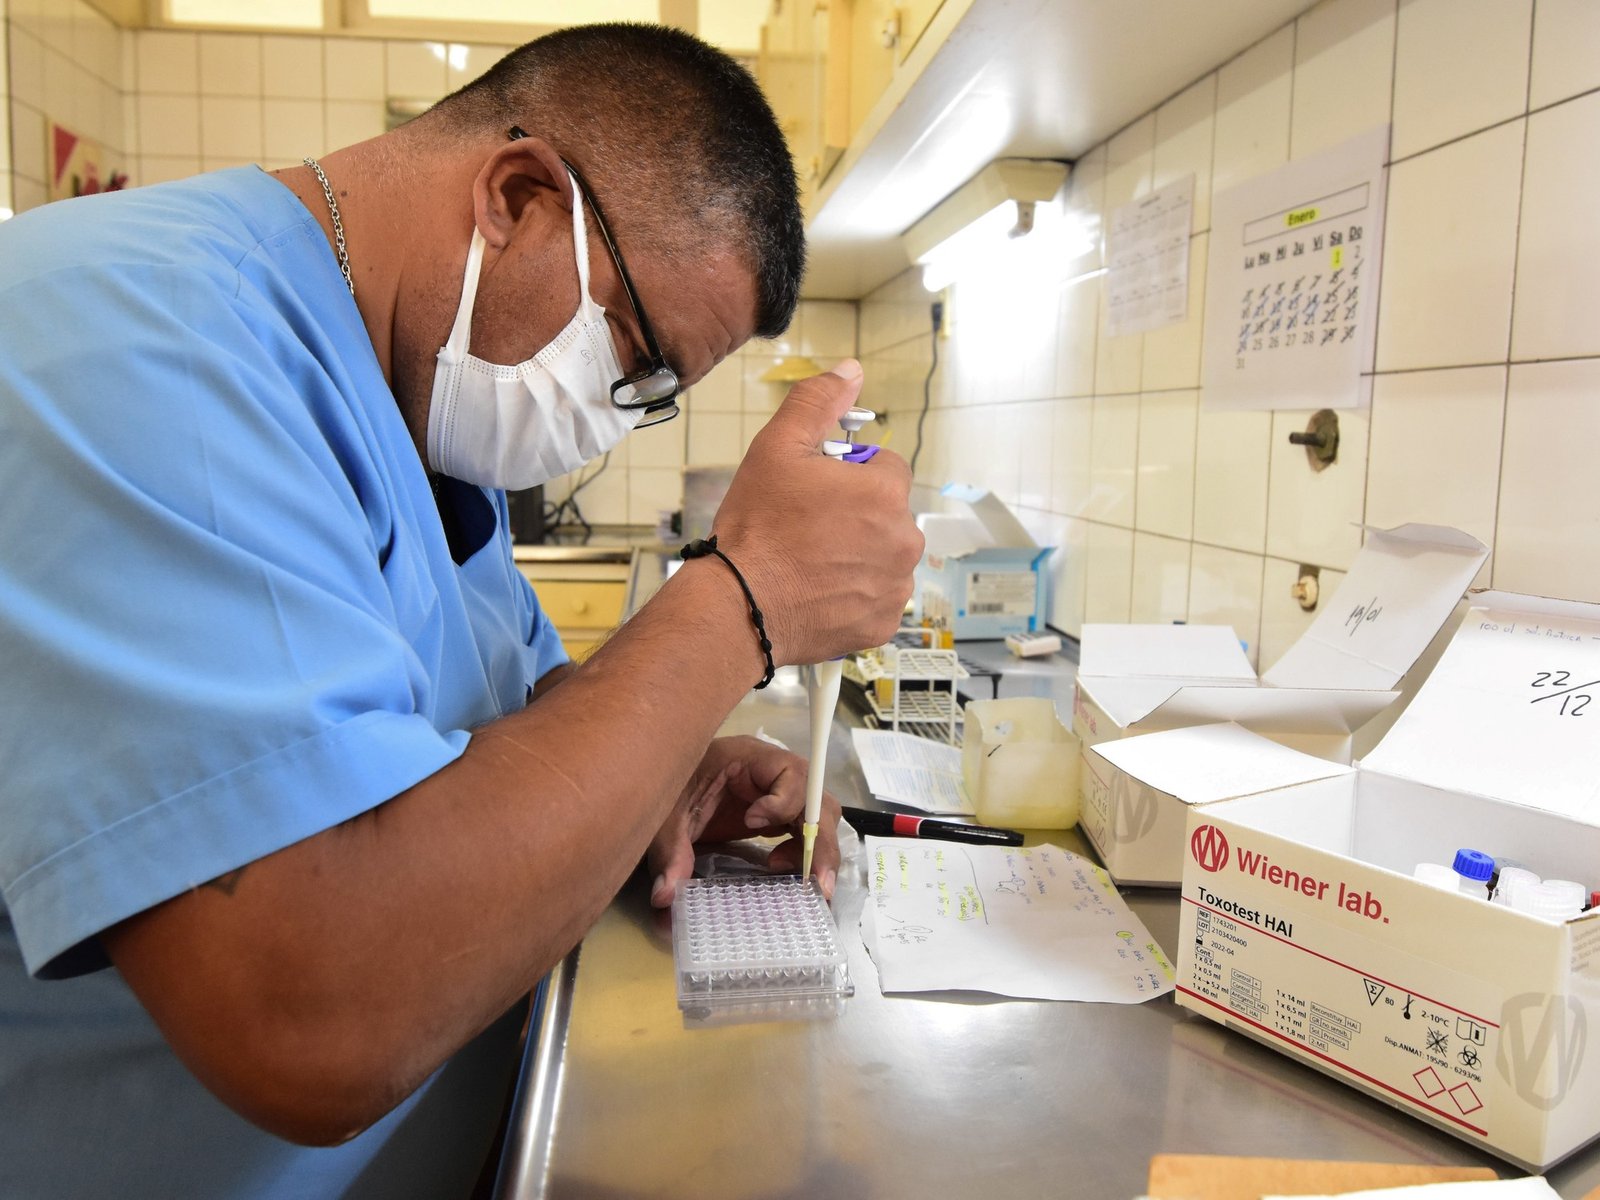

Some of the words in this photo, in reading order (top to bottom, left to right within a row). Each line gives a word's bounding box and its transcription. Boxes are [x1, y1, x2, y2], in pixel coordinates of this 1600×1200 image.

[1287, 208, 1316, 227] Enero
[1313, 234, 1324, 251] Vi
[1348, 225, 1363, 242] Do
[1252, 338, 1263, 351] 25
[1285, 333, 1297, 347] 27
[1302, 331, 1315, 344] 28
[1236, 847, 1329, 901] Wiener
[1338, 882, 1390, 924] lab.
[1198, 886, 1261, 925] Toxotest
[1264, 914, 1293, 938] HAI
[1199, 910, 1209, 919] REF
[1213, 916, 1237, 932] 1743201
[1198, 921, 1208, 930] LOT
[1211, 926, 1248, 947] 2103420400
[1211, 940, 1235, 956] 2022-04
[1385, 997, 1395, 1006] 80
[1347, 1021, 1358, 1030] HAI
[1426, 1054, 1448, 1069] 195/90
[1454, 1066, 1482, 1083] 6293/96
